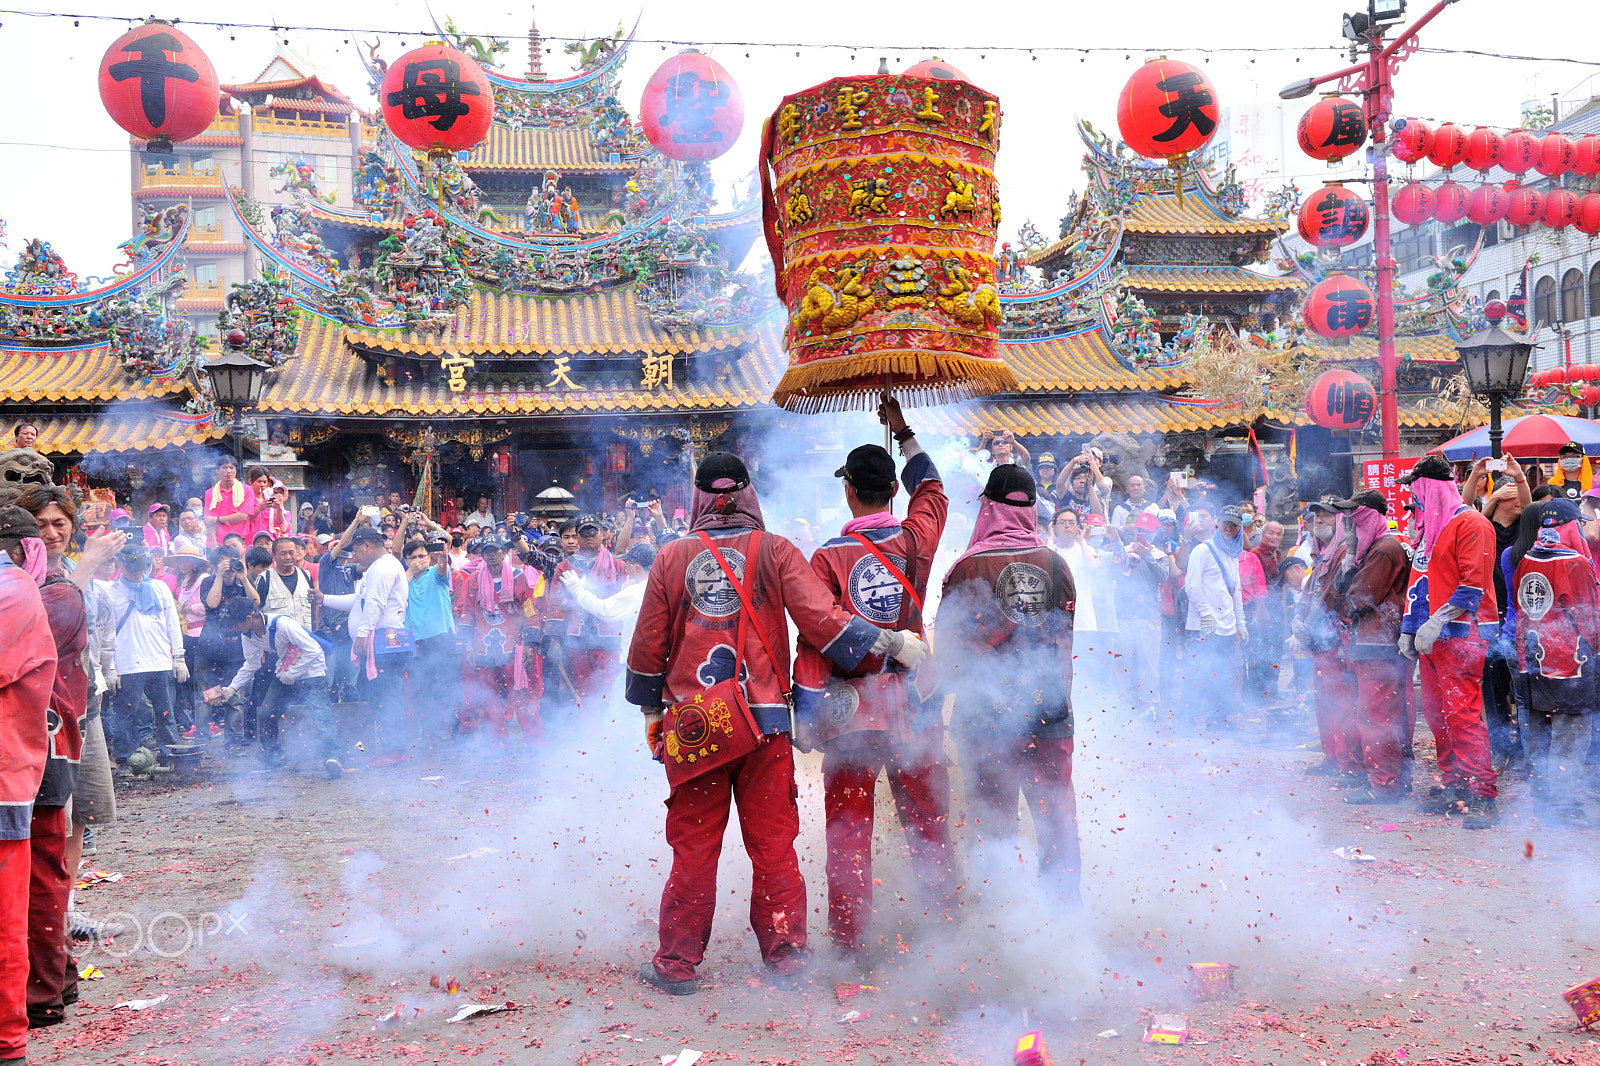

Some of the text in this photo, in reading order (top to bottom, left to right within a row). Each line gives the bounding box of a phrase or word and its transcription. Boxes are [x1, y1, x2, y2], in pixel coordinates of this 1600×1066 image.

[109, 32, 200, 129] 千
[387, 59, 480, 131] 母
[659, 71, 731, 143] 聖
[1152, 72, 1216, 142] 天
[1325, 289, 1374, 331] 雨
[441, 350, 674, 392] 朝天宮
[1327, 380, 1374, 425] 順
